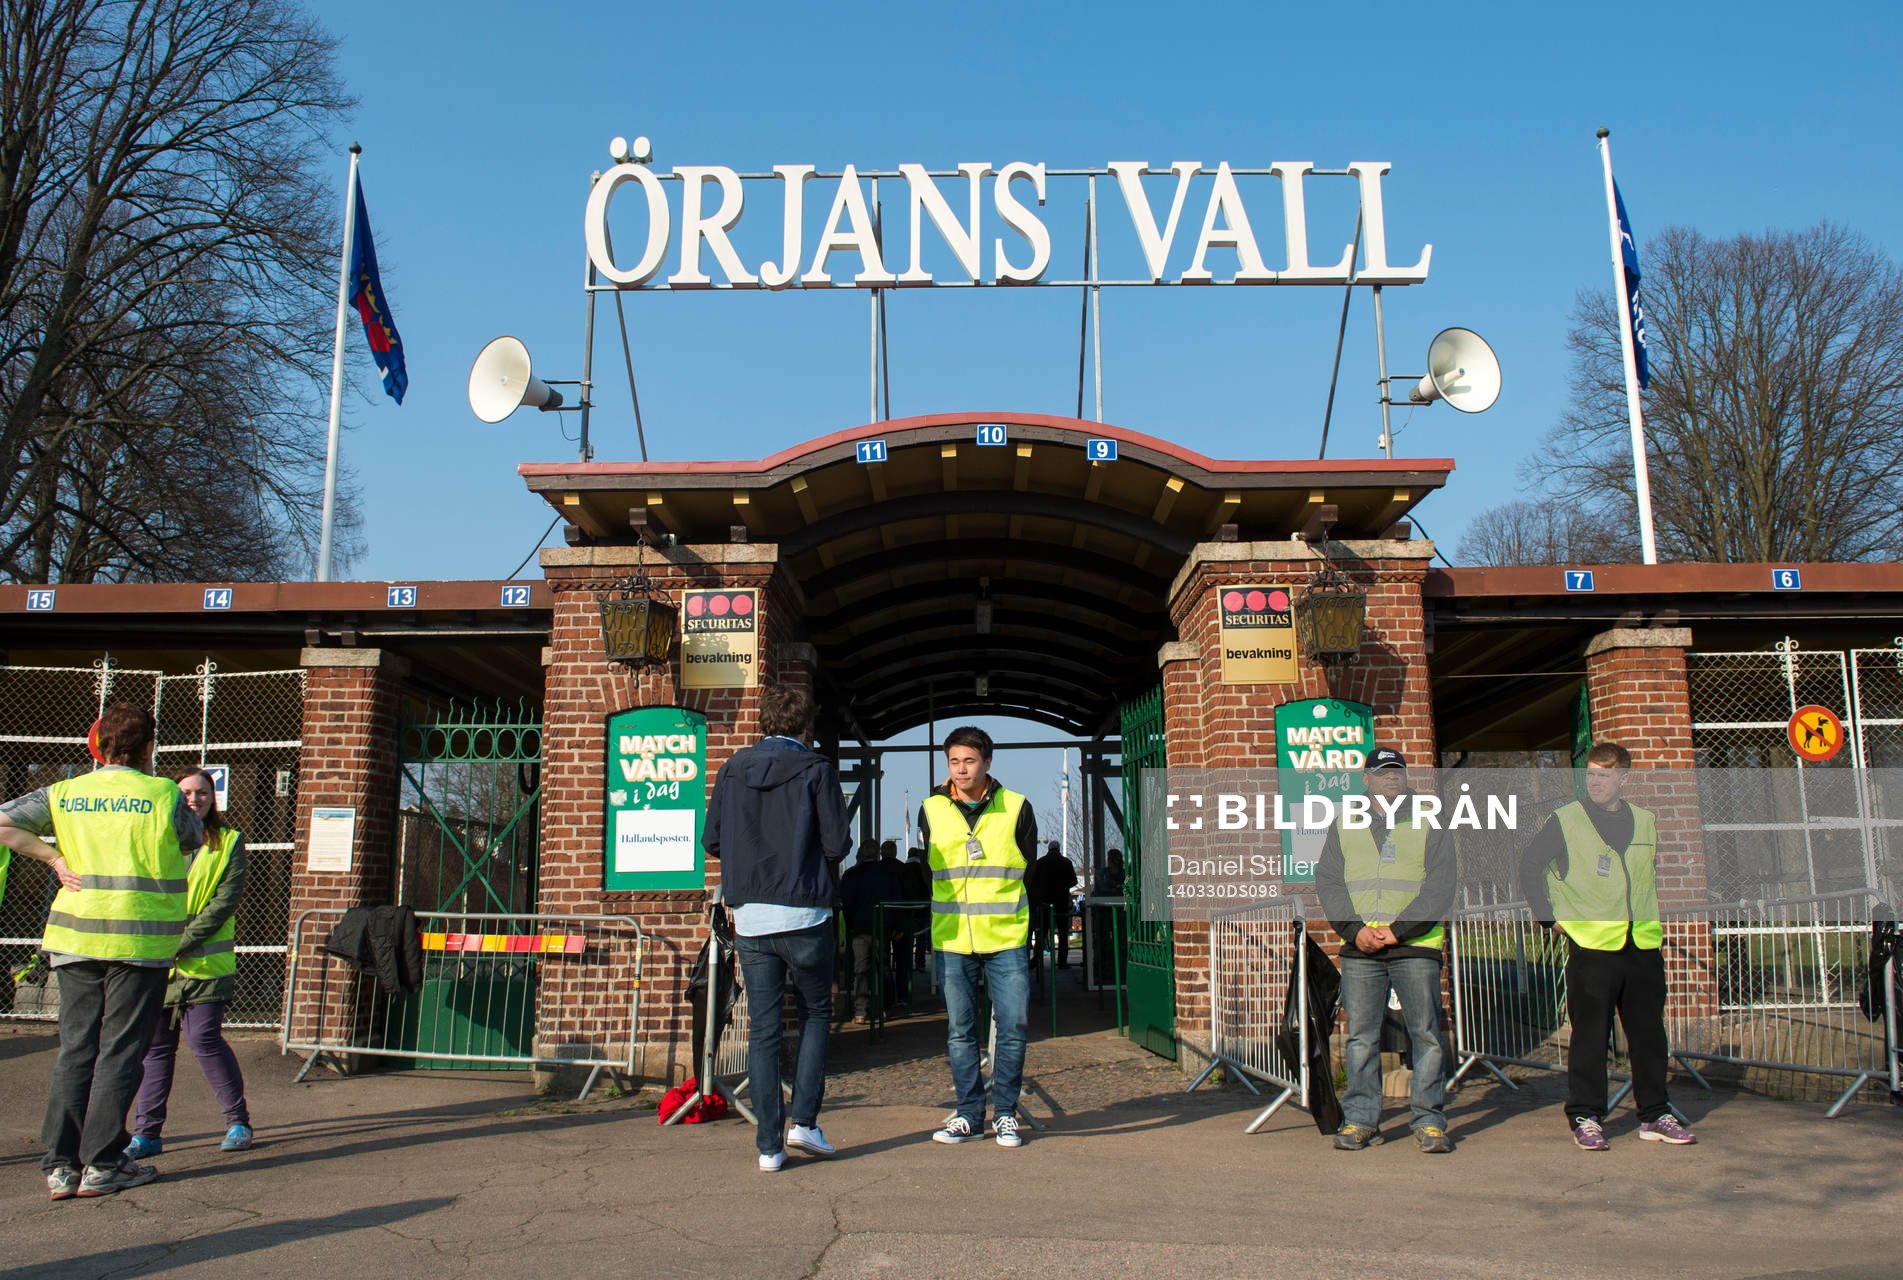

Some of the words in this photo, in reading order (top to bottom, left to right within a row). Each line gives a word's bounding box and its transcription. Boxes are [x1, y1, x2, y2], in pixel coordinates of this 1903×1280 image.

[585, 136, 1052, 290] ÖRJANS
[1107, 161, 1433, 285] VALL
[980, 427, 1003, 443] 10
[861, 443, 881, 460] 11
[1096, 442, 1108, 458] 9
[1573, 573, 1585, 589] 7
[1781, 572, 1793, 587] 6
[30, 592, 51, 608] 15
[207, 591, 228, 607] 14
[390, 588, 413, 605] 13
[504, 588, 527, 604] 12
[687, 618, 752, 630] SECURITAS
[1225, 614, 1289, 625] SECURITAS
[686, 652, 752, 664] bevakning
[1226, 648, 1292, 660] bevakning
[1286, 725, 1363, 746] MATCH
[619, 734, 697, 754] MATCH
[1288, 743, 1366, 773] VÄRD
[619, 751, 698, 782] VÄRD
[1304, 780, 1312, 795] i
[1315, 772, 1350, 791] dag
[632, 788, 641, 804] i
[644, 780, 680, 800] dag
